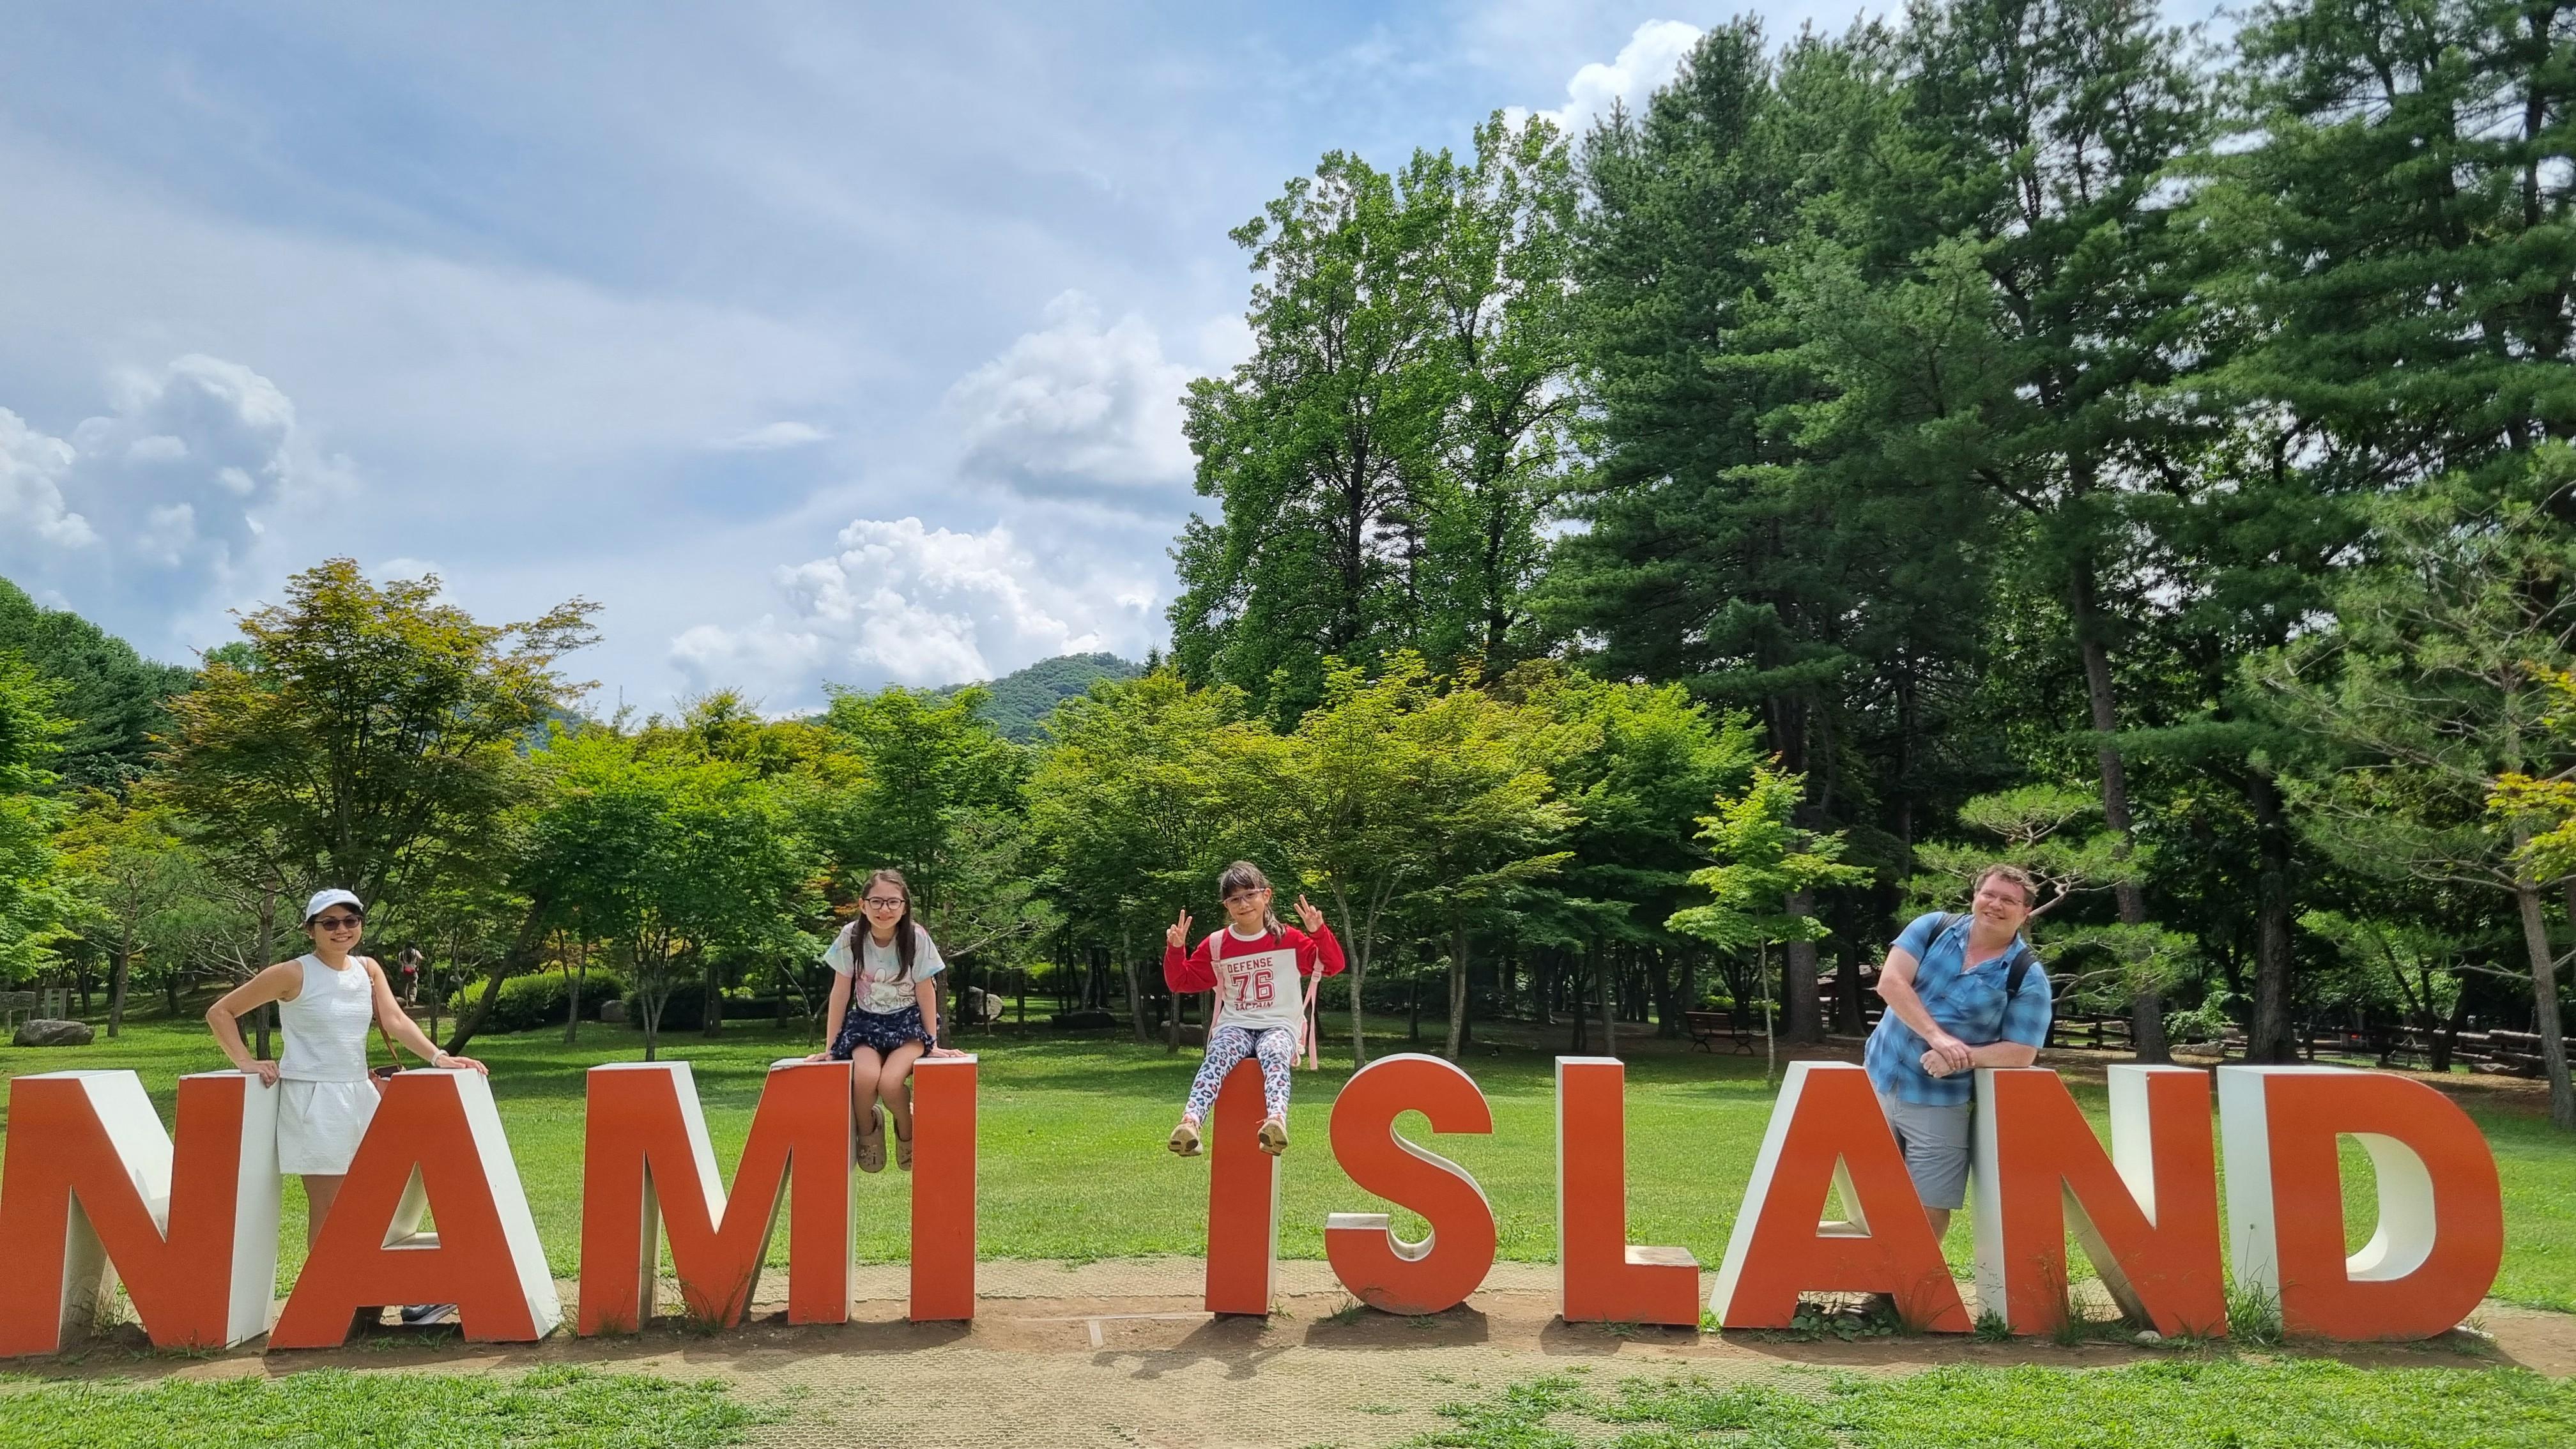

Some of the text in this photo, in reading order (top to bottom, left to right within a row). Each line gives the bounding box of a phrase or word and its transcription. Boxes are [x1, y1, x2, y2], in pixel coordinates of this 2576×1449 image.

[1227, 957, 1273, 974] DEFENSE
[1230, 968, 1275, 1002] 76
[0, 1053, 2504, 1358] NAMI ISLAND
